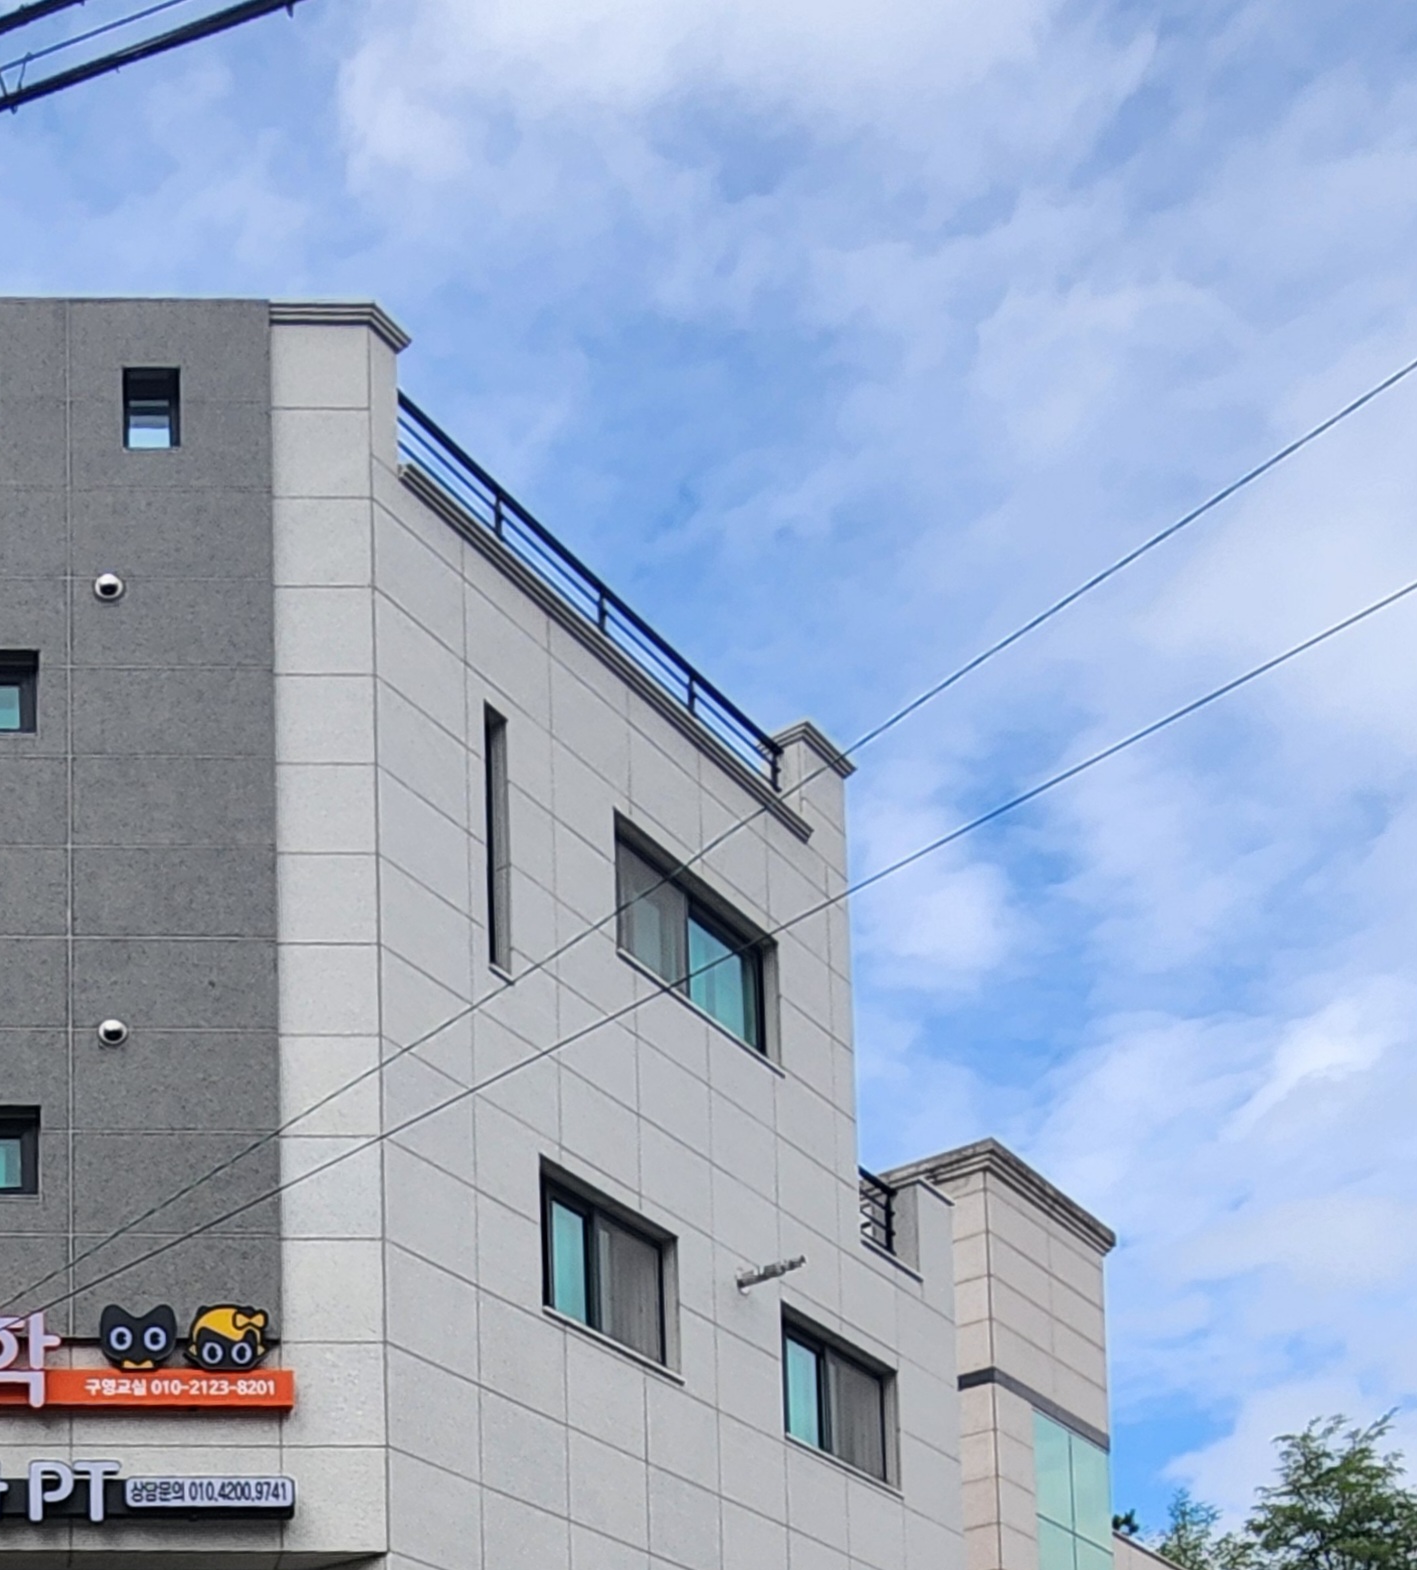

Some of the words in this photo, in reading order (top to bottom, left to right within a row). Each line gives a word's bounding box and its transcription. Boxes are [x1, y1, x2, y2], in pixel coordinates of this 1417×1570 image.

[85, 1378, 146, 1396] 구영교실
[151, 1378, 275, 1396] 010-2123-8201
[27, 1459, 121, 1522] PT
[130, 1481, 184, 1503] 상담문의
[188, 1481, 287, 1502] 010.4200.9741
